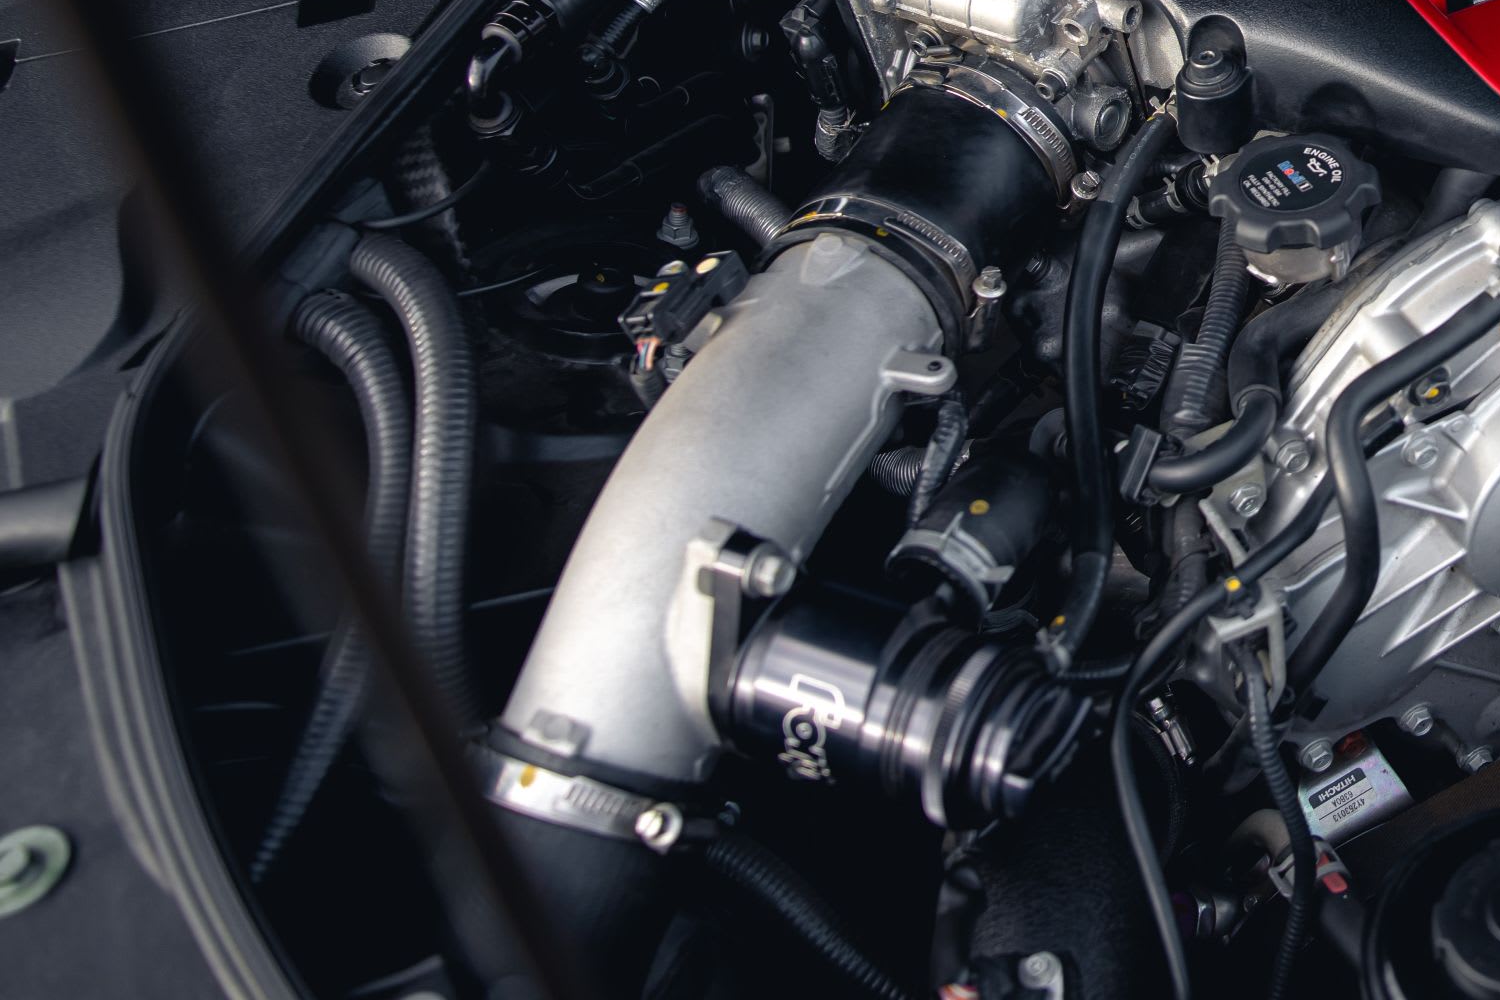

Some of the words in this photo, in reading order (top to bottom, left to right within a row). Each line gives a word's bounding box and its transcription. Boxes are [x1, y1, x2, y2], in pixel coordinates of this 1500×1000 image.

[1303, 147, 1340, 169] ENGINE
[1331, 170, 1342, 183] OIL
[1318, 774, 1356, 802] HITACHI
